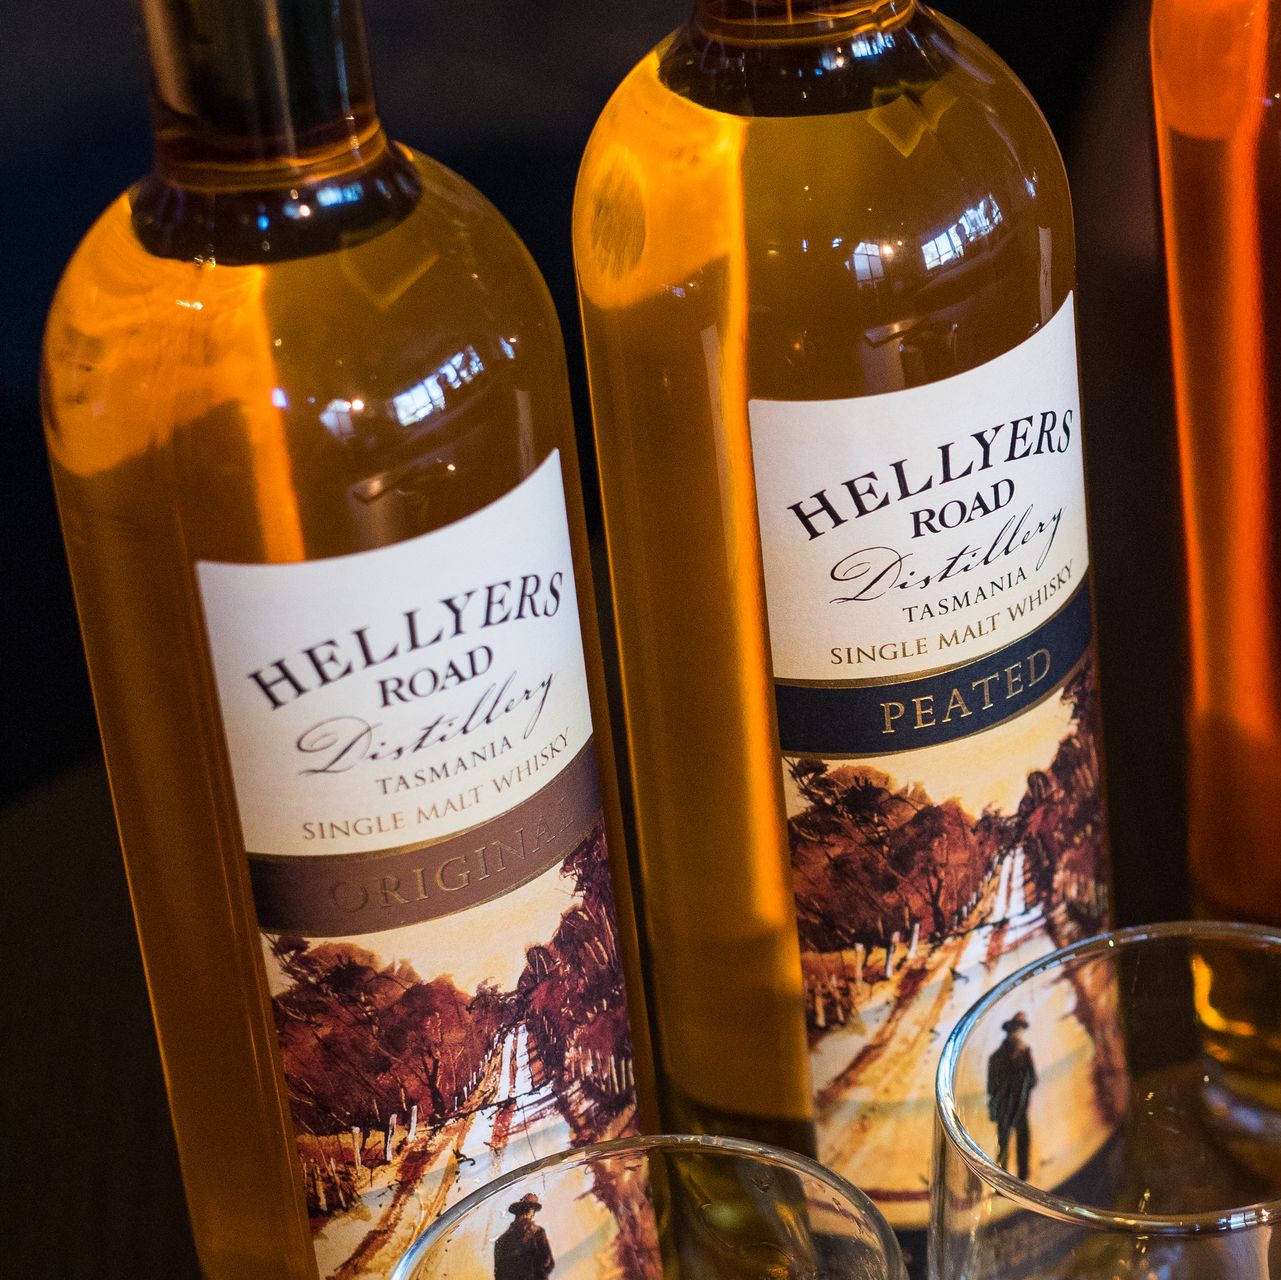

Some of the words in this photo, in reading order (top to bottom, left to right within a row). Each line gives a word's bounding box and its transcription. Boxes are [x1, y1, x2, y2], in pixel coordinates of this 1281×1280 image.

[787, 408, 1074, 541] HELLYERS
[910, 478, 1015, 540] ROAD
[829, 503, 1068, 604] Distillery
[902, 566, 1028, 624] TASMANIA
[247, 572, 564, 710] HELLYERS
[830, 637, 929, 666] SINGLE
[937, 613, 1001, 651] MALT
[1007, 558, 1075, 625] WHISKY
[296, 670, 558, 777] Distillery
[377, 645, 494, 708] ROAD
[880, 647, 1053, 735] PEATED
[302, 811, 406, 841] SINGLE
[416, 784, 485, 825] MALT
[492, 727, 571, 795] WHISKY
[376, 736, 514, 796] TASMANIA
[329, 795, 576, 914] ORIGINAL
